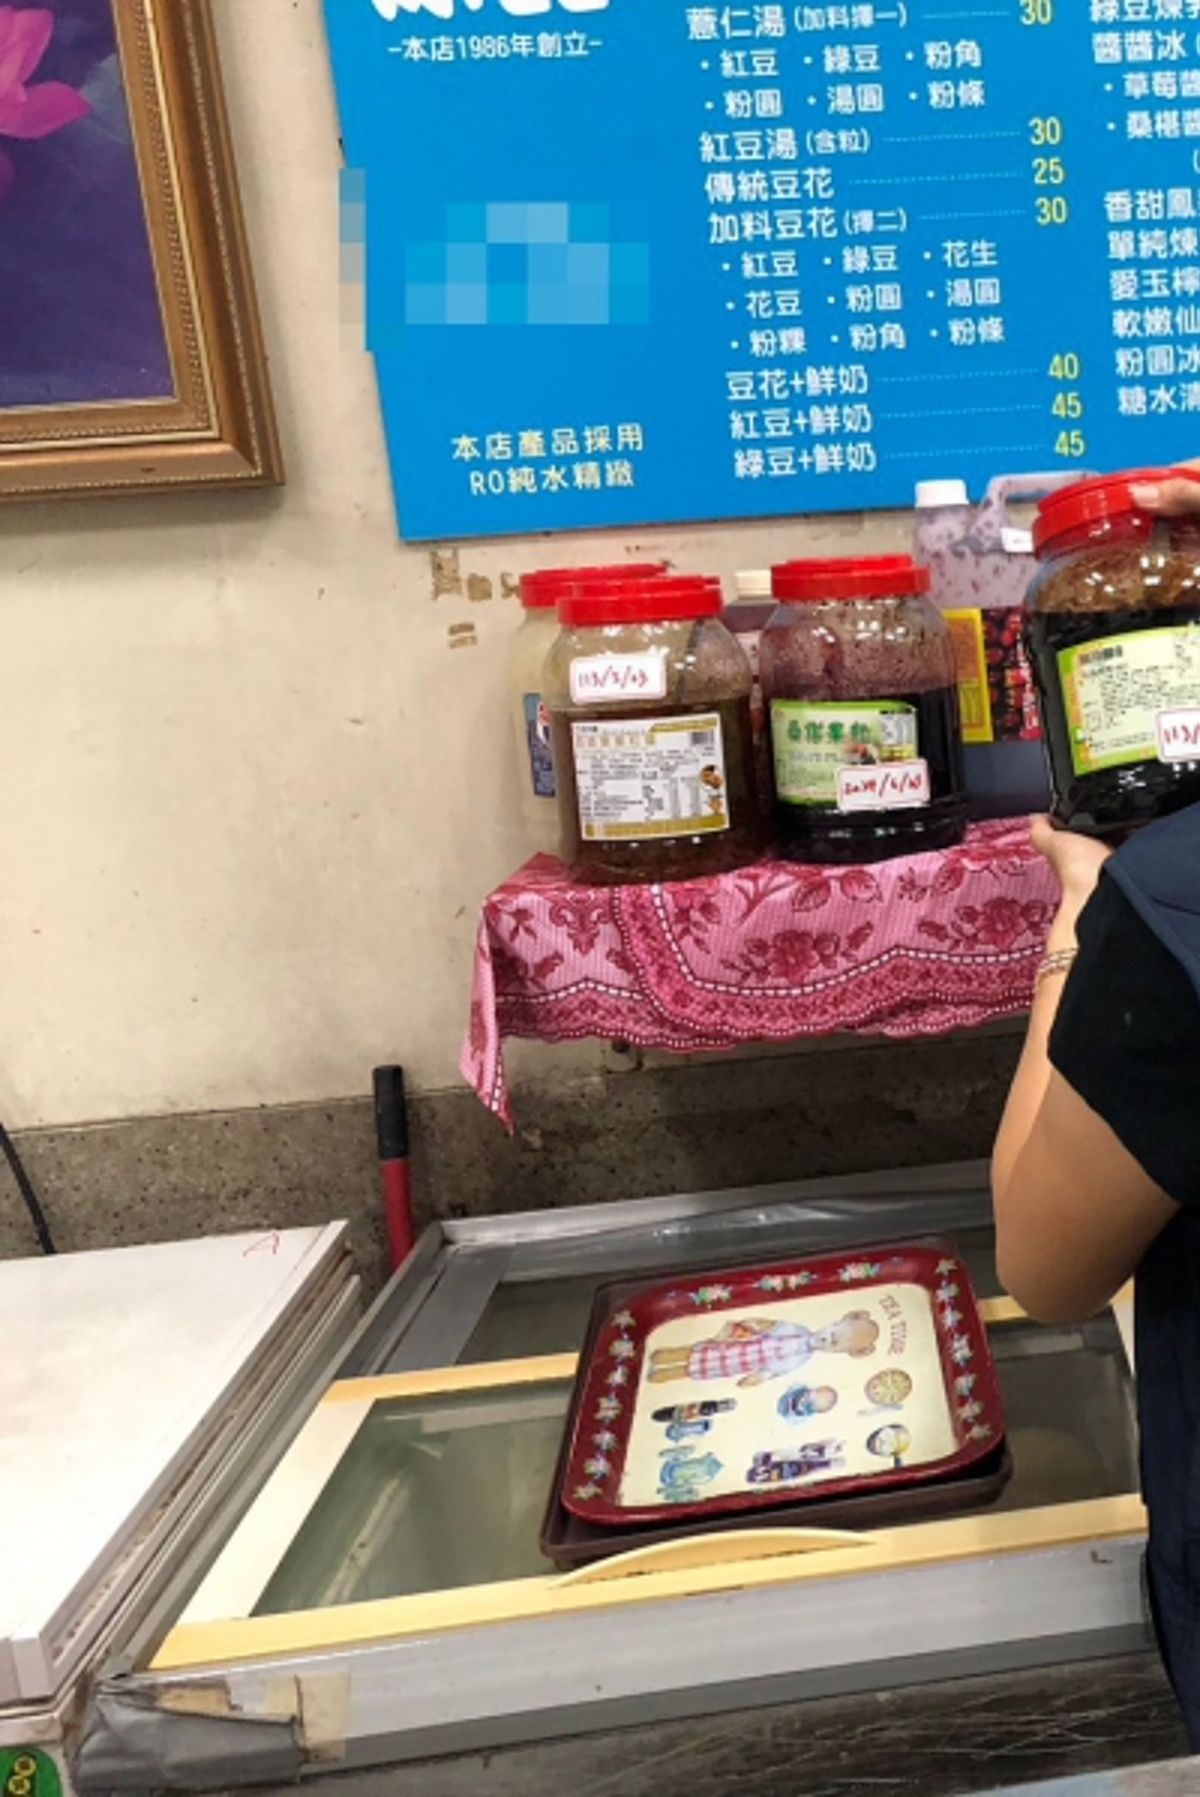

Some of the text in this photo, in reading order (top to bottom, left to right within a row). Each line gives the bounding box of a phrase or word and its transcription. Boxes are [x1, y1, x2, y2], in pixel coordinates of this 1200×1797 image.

[687, 5, 786, 40] 薏仁湯
[1020, 0, 1051, 25] 30
[720, 40, 981, 77] 紅豆 綠豆 粉角
[724, 80, 984, 118] 粉圓 湯圓 粉條
[700, 128, 797, 162] 紅豆湯
[1029, 117, 1061, 145] 30
[705, 158, 1064, 203] 傳統豆花 25
[709, 207, 837, 243] 加料豆花
[1036, 197, 1067, 225] 30
[742, 240, 997, 278] 紅豆 綠豆 花生
[746, 278, 1000, 318] 花豆 粉圓 湯圓
[850, 323, 906, 351] 粉角
[949, 316, 1003, 344] 粉條
[727, 353, 1078, 401] 豆花+鮮奶 40
[730, 392, 1081, 440] 紅豆+鮮奶 45
[735, 430, 1084, 478] 綠豆+鮮奶 45
